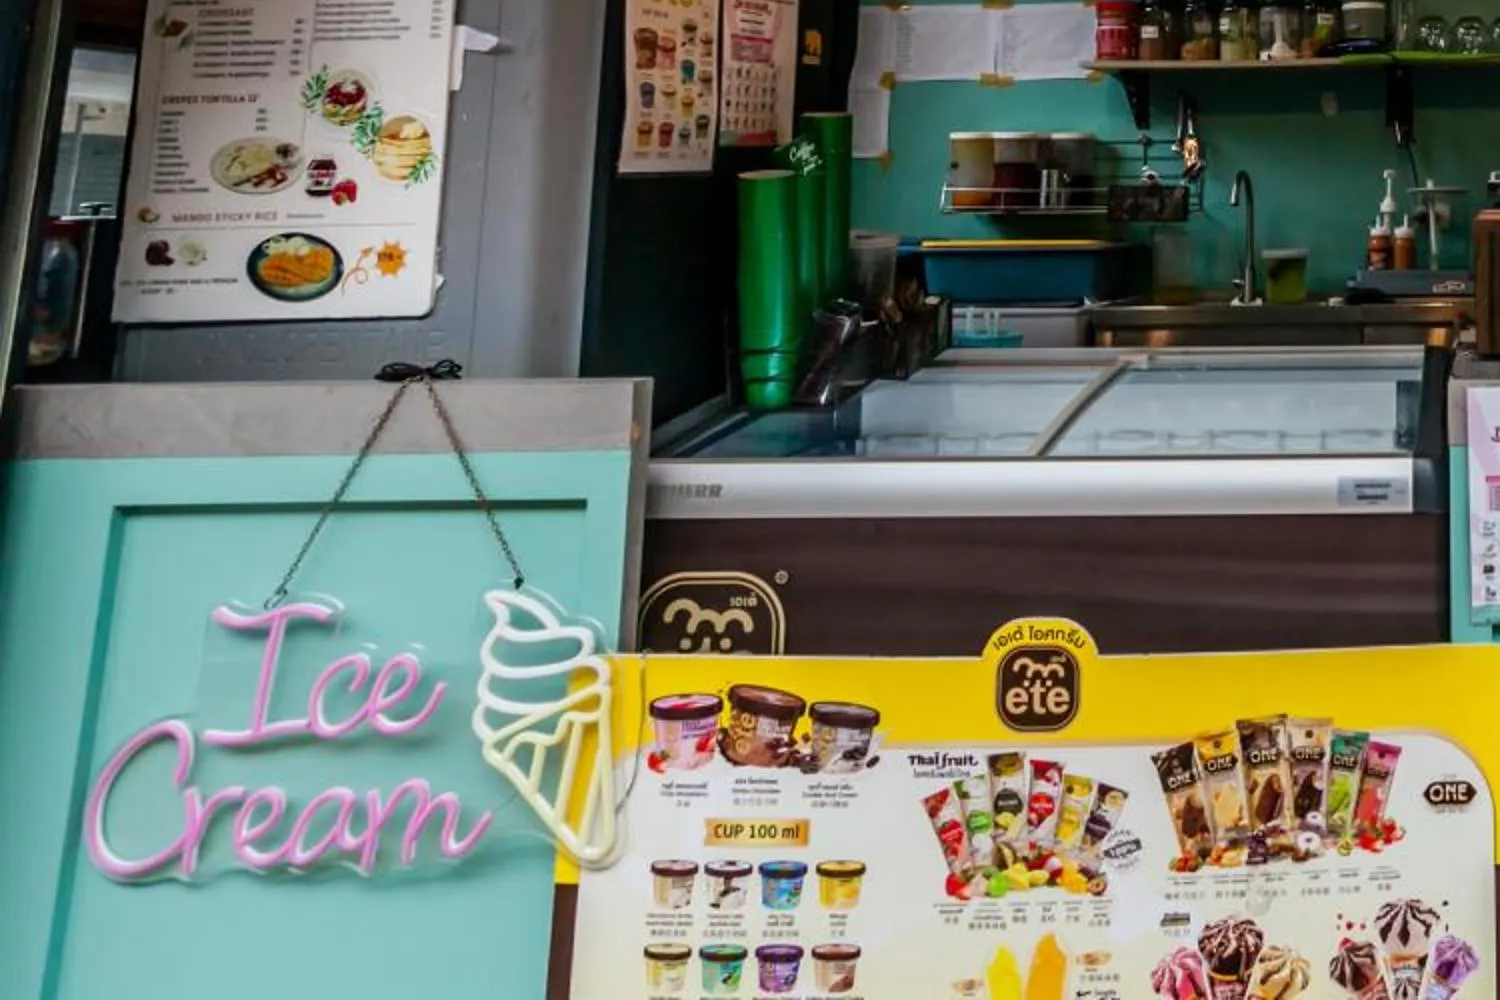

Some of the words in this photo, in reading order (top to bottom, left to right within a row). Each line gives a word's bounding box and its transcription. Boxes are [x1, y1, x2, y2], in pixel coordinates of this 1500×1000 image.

[203, 601, 448, 747] Ice
[1208, 757, 1233, 771] ONE
[1251, 748, 1278, 763] ONE
[1168, 771, 1193, 787] ONE
[85, 718, 493, 879] Cream
[1429, 784, 1469, 801] ONE
[713, 823, 745, 840] CUP
[749, 823, 778, 839] 100
[781, 823, 800, 839] ml
